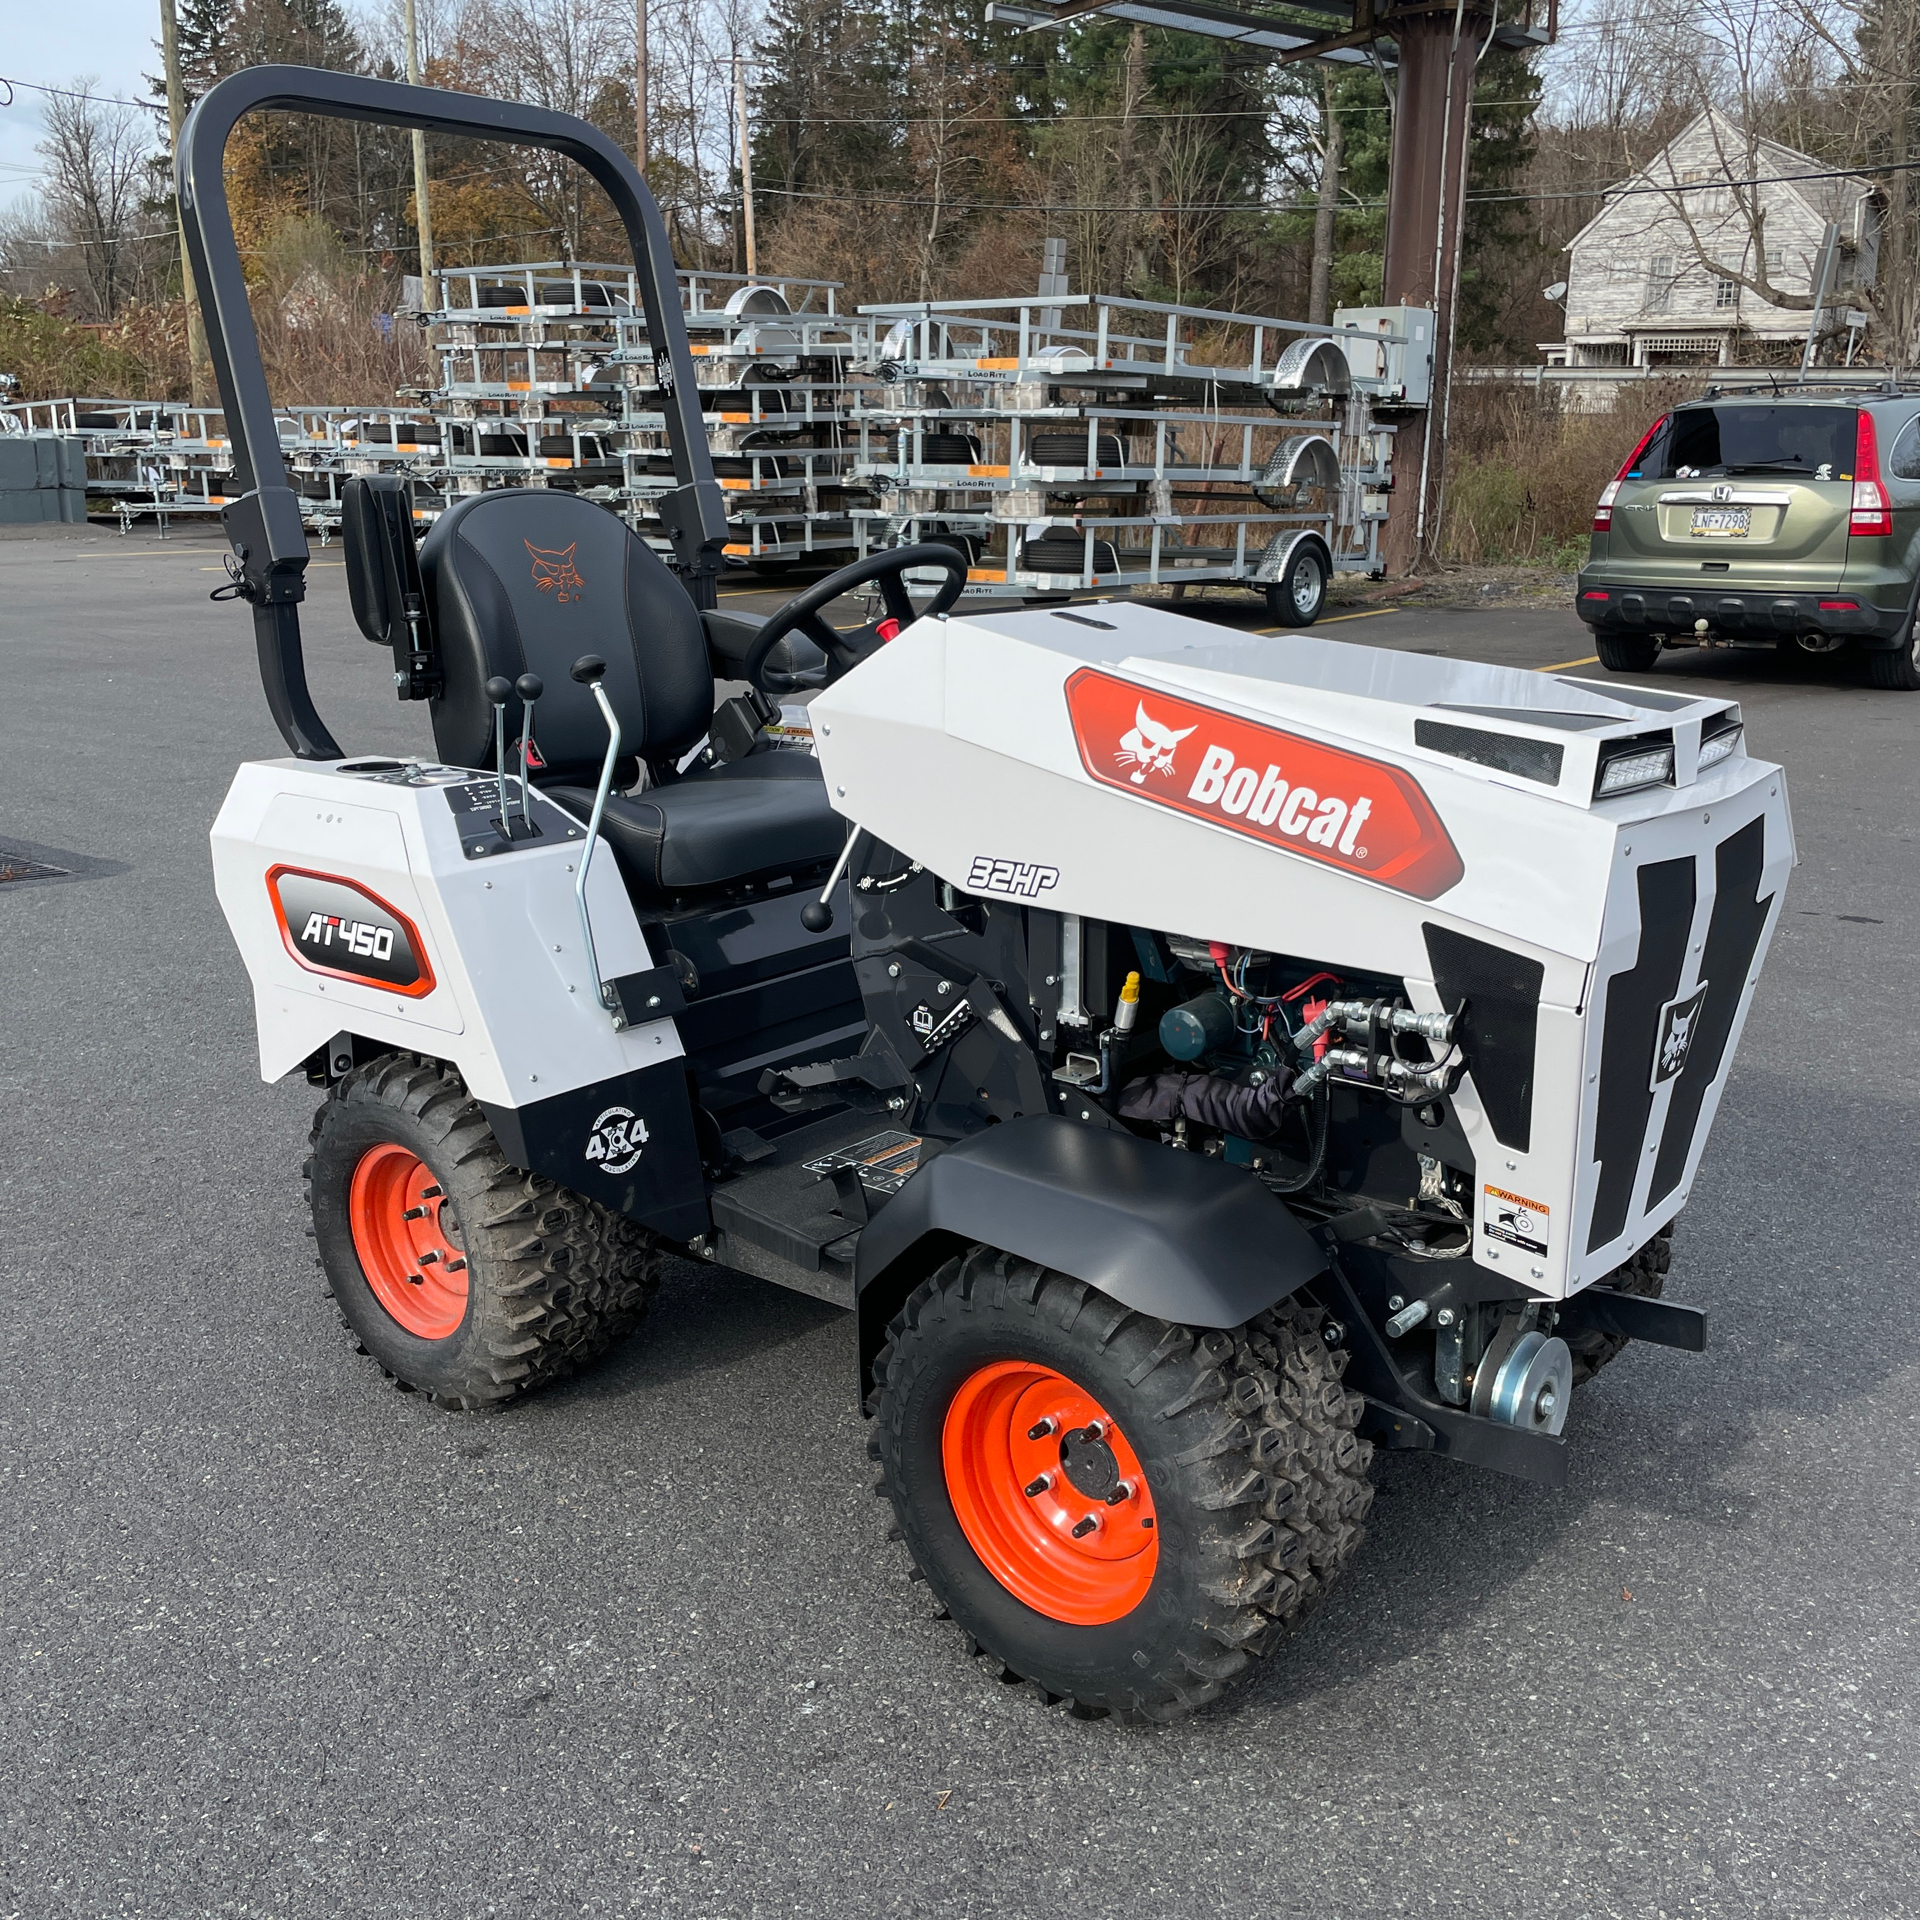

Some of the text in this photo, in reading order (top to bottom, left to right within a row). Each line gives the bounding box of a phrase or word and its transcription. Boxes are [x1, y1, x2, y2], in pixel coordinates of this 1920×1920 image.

[1187, 744, 1372, 855] Bobcat
[967, 856, 1060, 898] 32HP
[301, 912, 394, 962] AT450
[595, 1108, 631, 1127] ARTICULATING
[604, 1154, 639, 1172] OSCILLATING
[1499, 1190, 1546, 1213] WARNING
